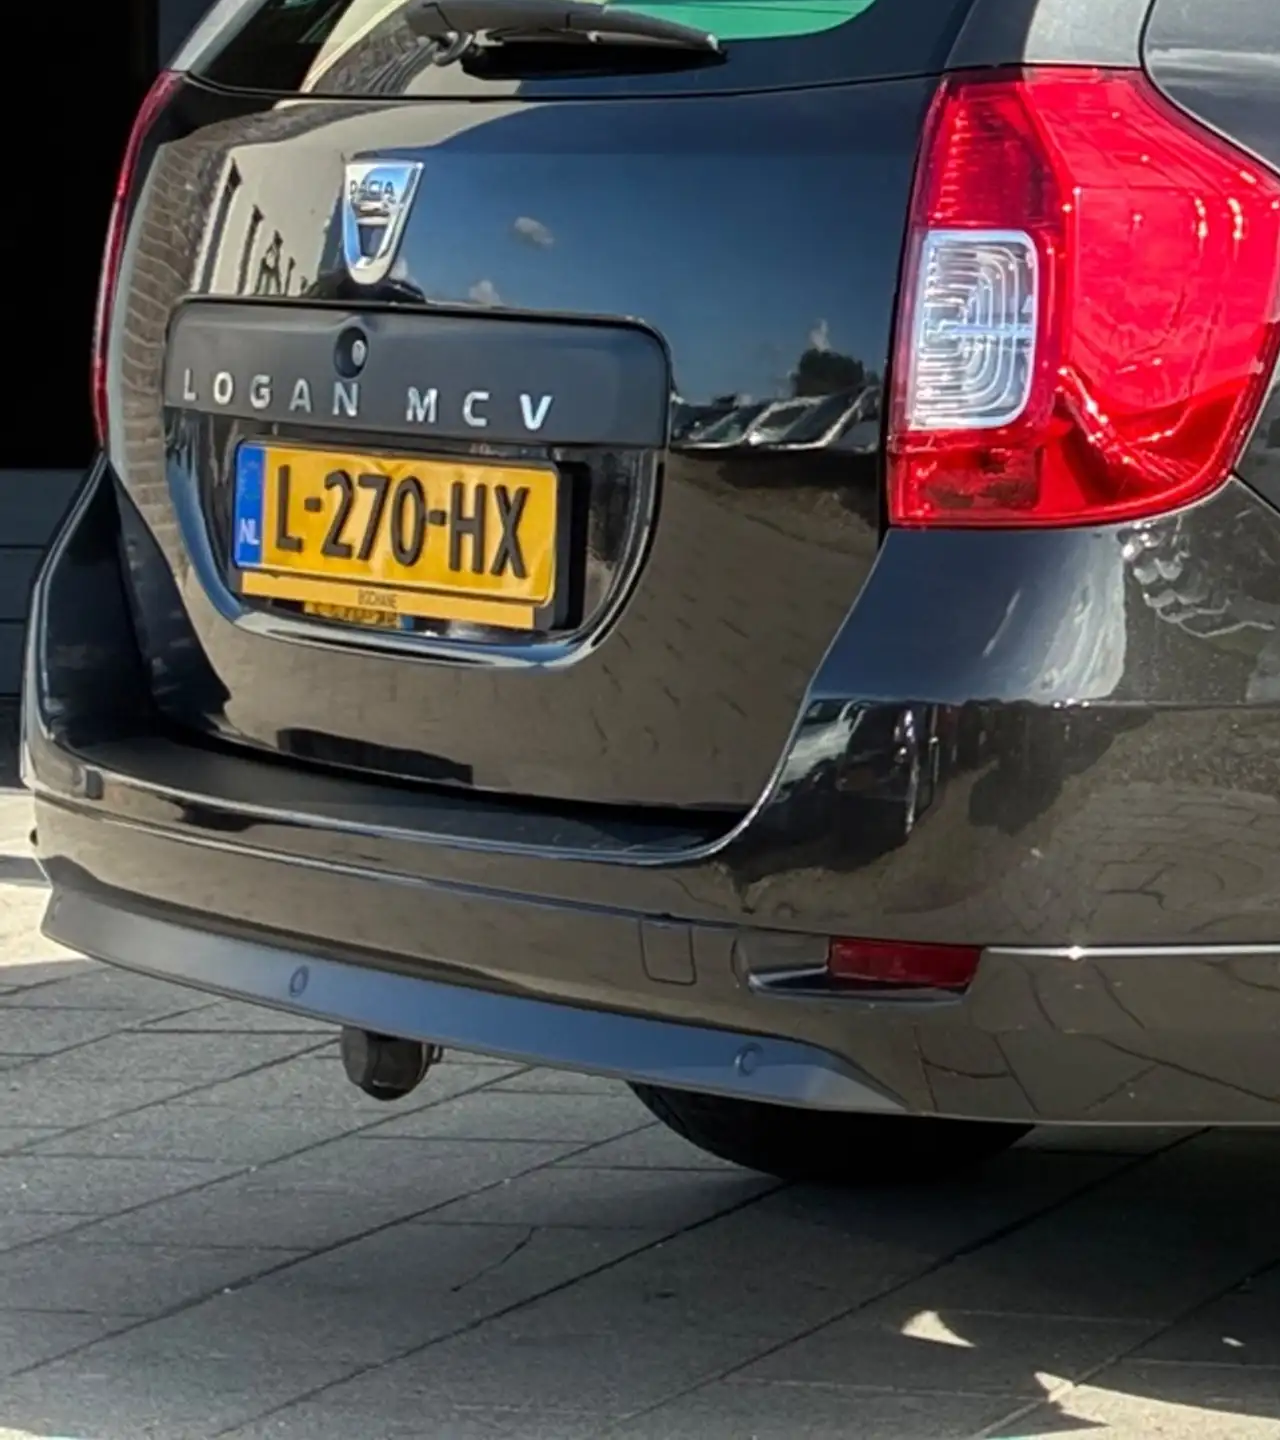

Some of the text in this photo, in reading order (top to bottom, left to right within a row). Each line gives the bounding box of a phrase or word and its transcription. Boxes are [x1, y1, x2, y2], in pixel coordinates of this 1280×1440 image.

[183, 368, 360, 417] LOGAN
[238, 517, 260, 546] NL
[275, 463, 531, 579] L-270-HX
